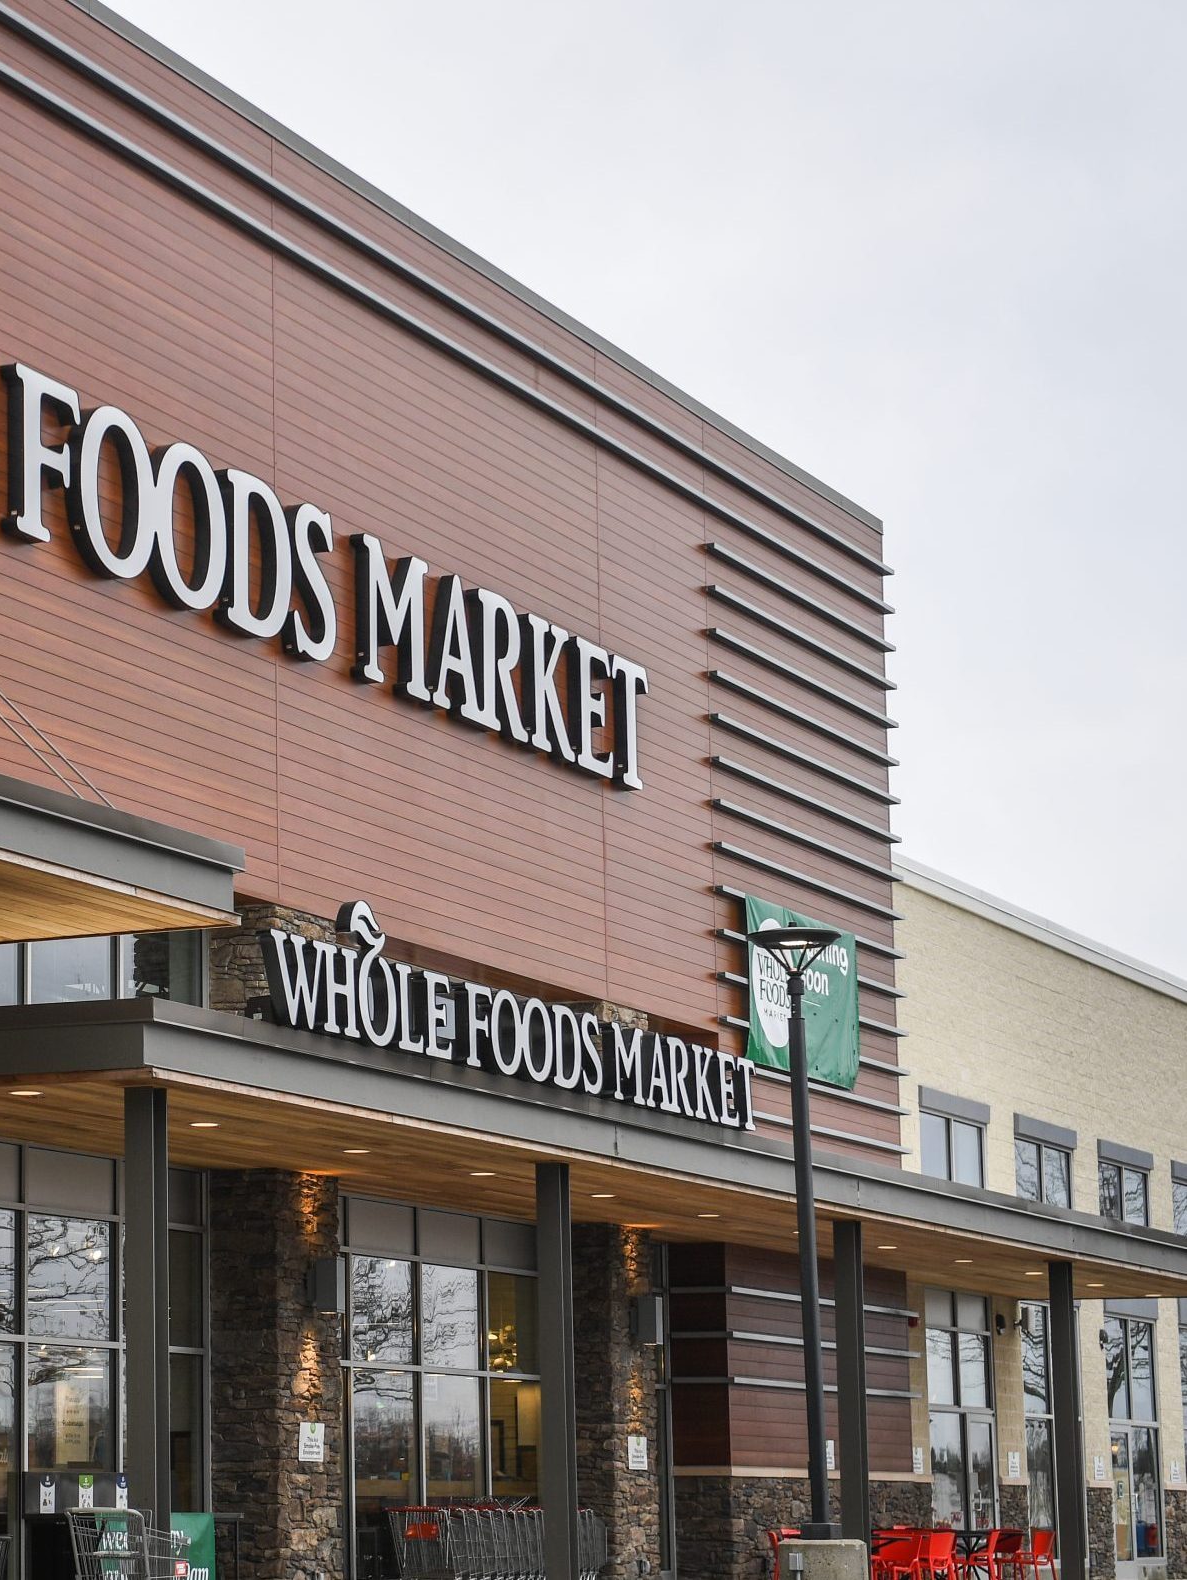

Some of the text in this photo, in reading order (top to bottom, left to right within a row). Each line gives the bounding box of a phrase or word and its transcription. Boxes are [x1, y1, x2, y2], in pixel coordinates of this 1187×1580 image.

[1, 362, 336, 661] FOODS
[350, 533, 648, 790] MARKET
[262, 902, 756, 1131] WHOLE FOODS MARKET
[757, 952, 789, 983] WHOL
[759, 979, 791, 1009] FOODS
